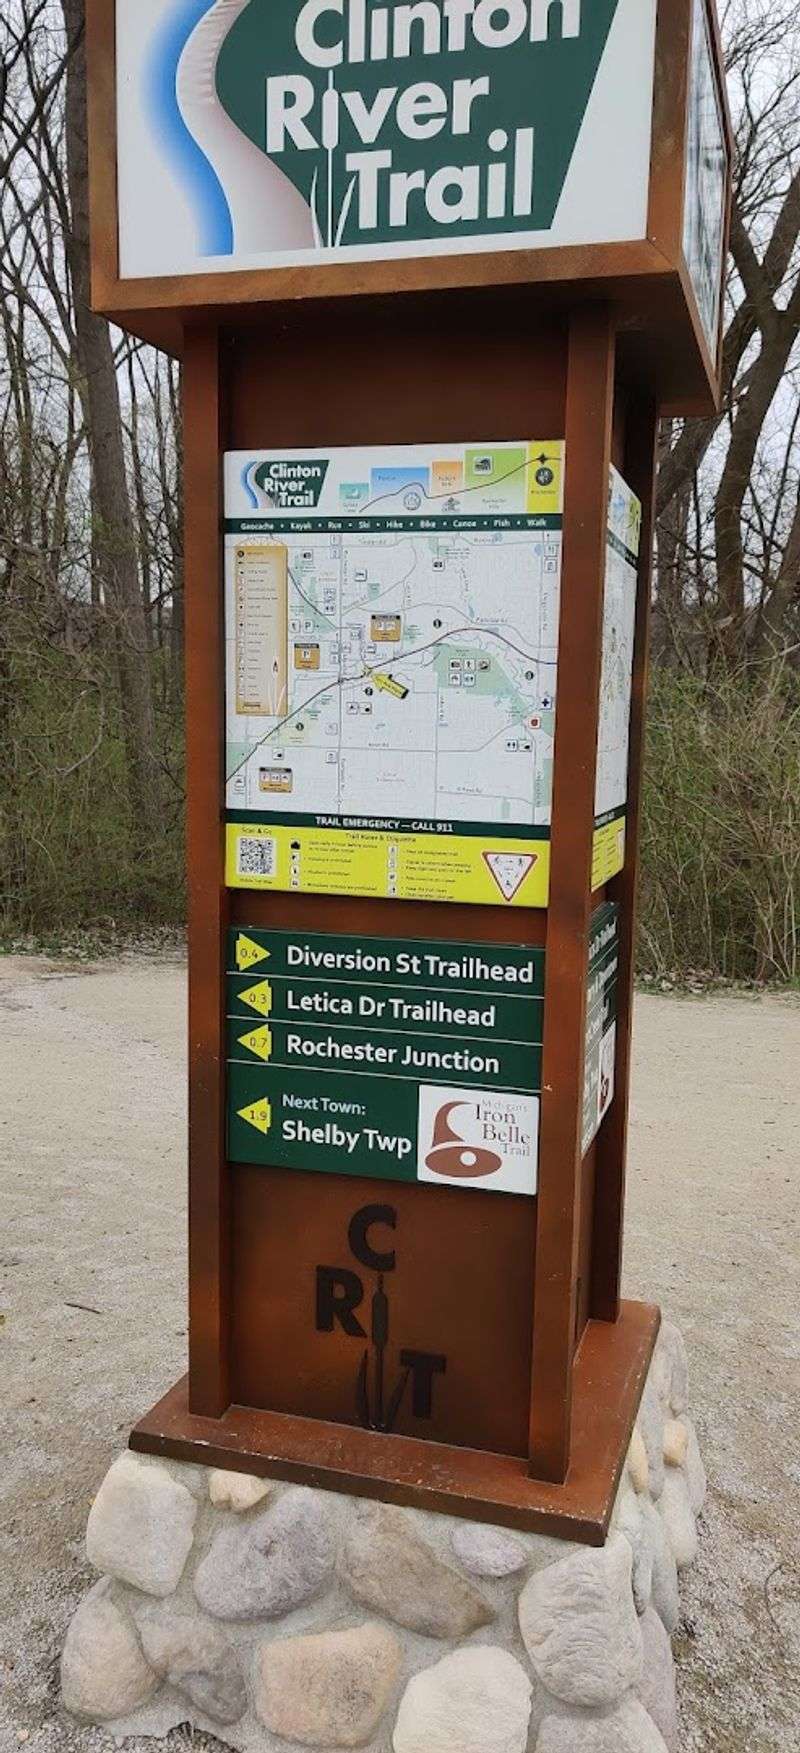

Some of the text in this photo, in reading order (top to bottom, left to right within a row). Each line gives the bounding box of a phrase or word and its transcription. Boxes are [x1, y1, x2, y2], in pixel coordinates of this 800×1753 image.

[295, 0, 581, 68] Clinton
[265, 70, 490, 154] River
[345, 127, 534, 230] Trail
[264, 477, 305, 492] River
[269, 462, 321, 478] Clinton
[279, 490, 314, 506] Trail
[240, 518, 547, 531] Geocache Kayak Run Ski Hike Bike Canoe Fish Walk
[314, 816, 341, 826] TRAIL
[342, 817, 400, 829] EMERGENCY
[410, 821, 436, 831] CALL
[436, 822, 454, 832] 911
[240, 945, 534, 983] 0.4 Diversion St Trailhead
[248, 990, 496, 1027] 0.3 Letica Dr Trailhead
[249, 1034, 500, 1074] 0.7 Rochester Junction
[282, 1093, 366, 1116] Next Town:
[475, 1103, 517, 1124] Iron
[249, 1110, 412, 1158] 1.9 Shelby Twp
[481, 1123, 531, 1145] Belle
[347, 1203, 397, 1272] C
[400, 1348, 447, 1419] T
